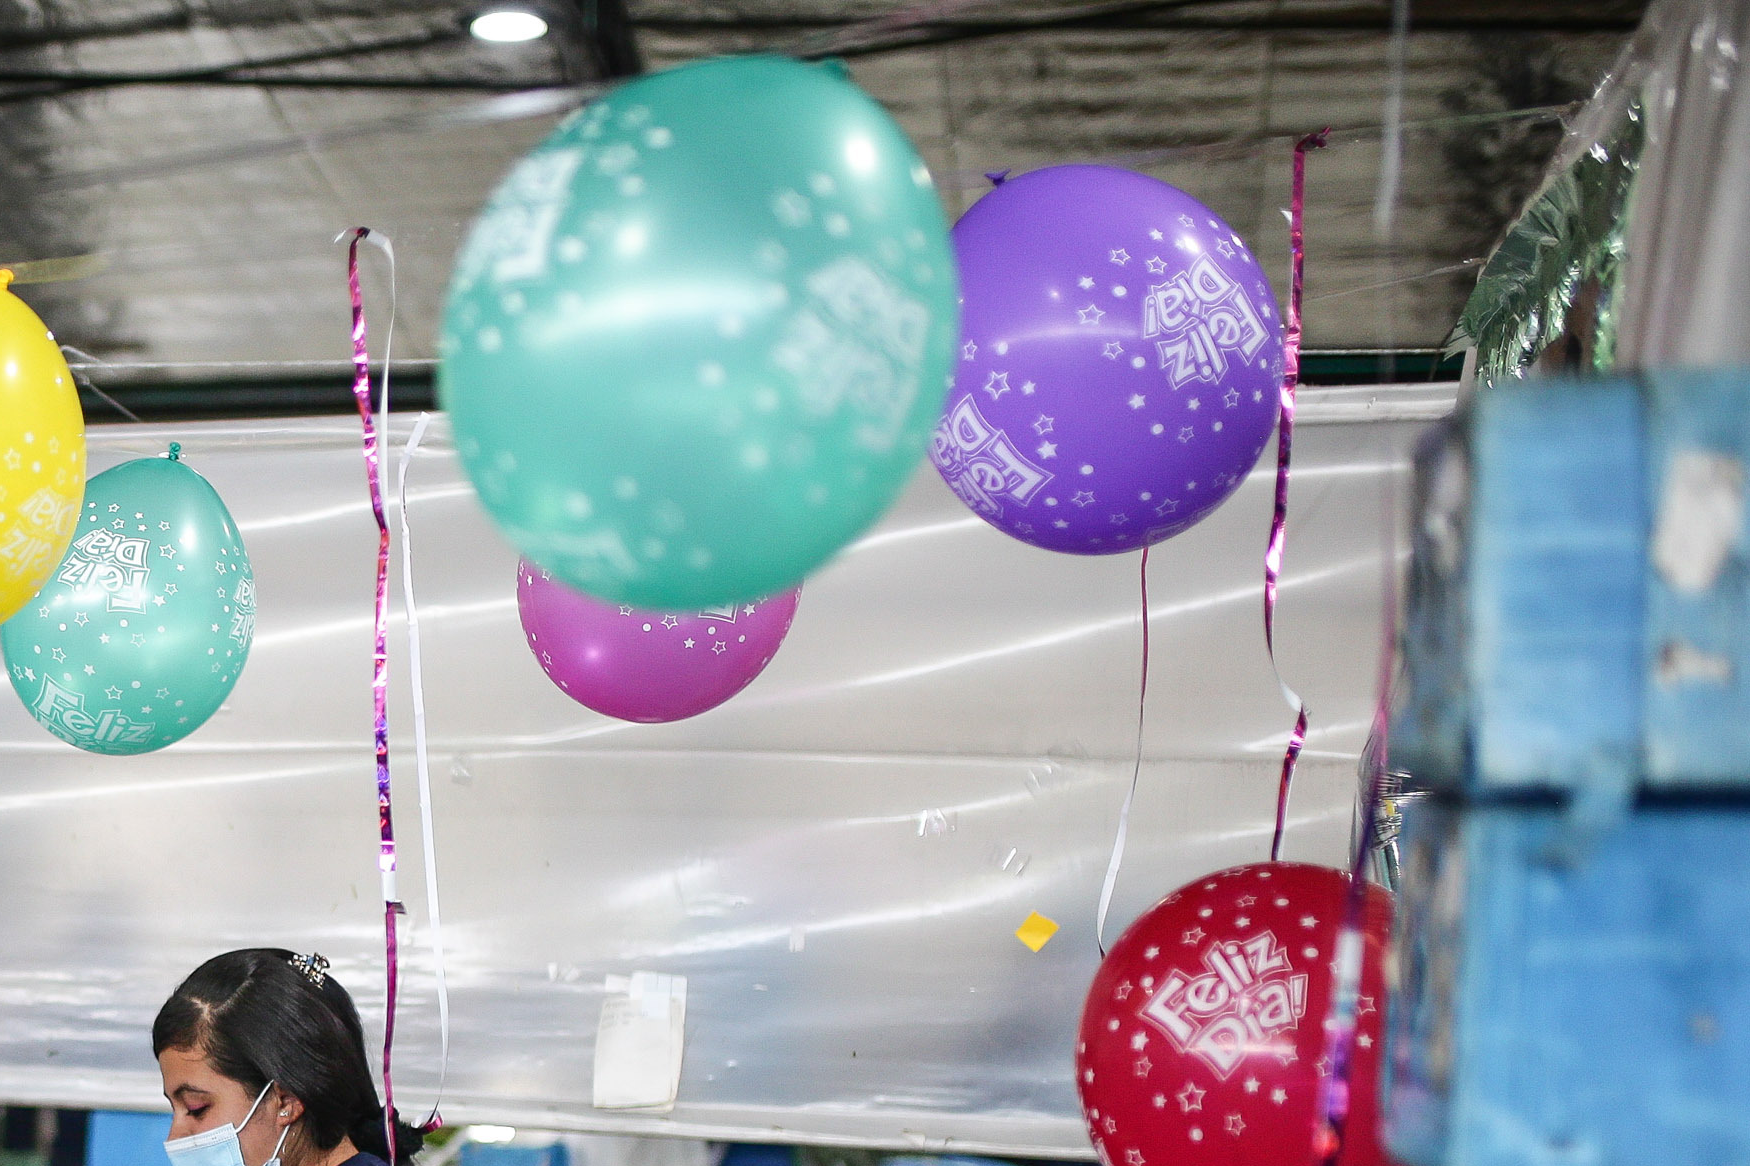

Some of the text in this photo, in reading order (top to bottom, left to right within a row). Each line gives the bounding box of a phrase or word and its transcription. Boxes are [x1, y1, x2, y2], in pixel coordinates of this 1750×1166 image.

[1160, 286, 1267, 387] Feliz
[57, 556, 149, 611] Feliz
[34, 675, 153, 744] Feliz
[1141, 932, 1290, 1047] Feliz
